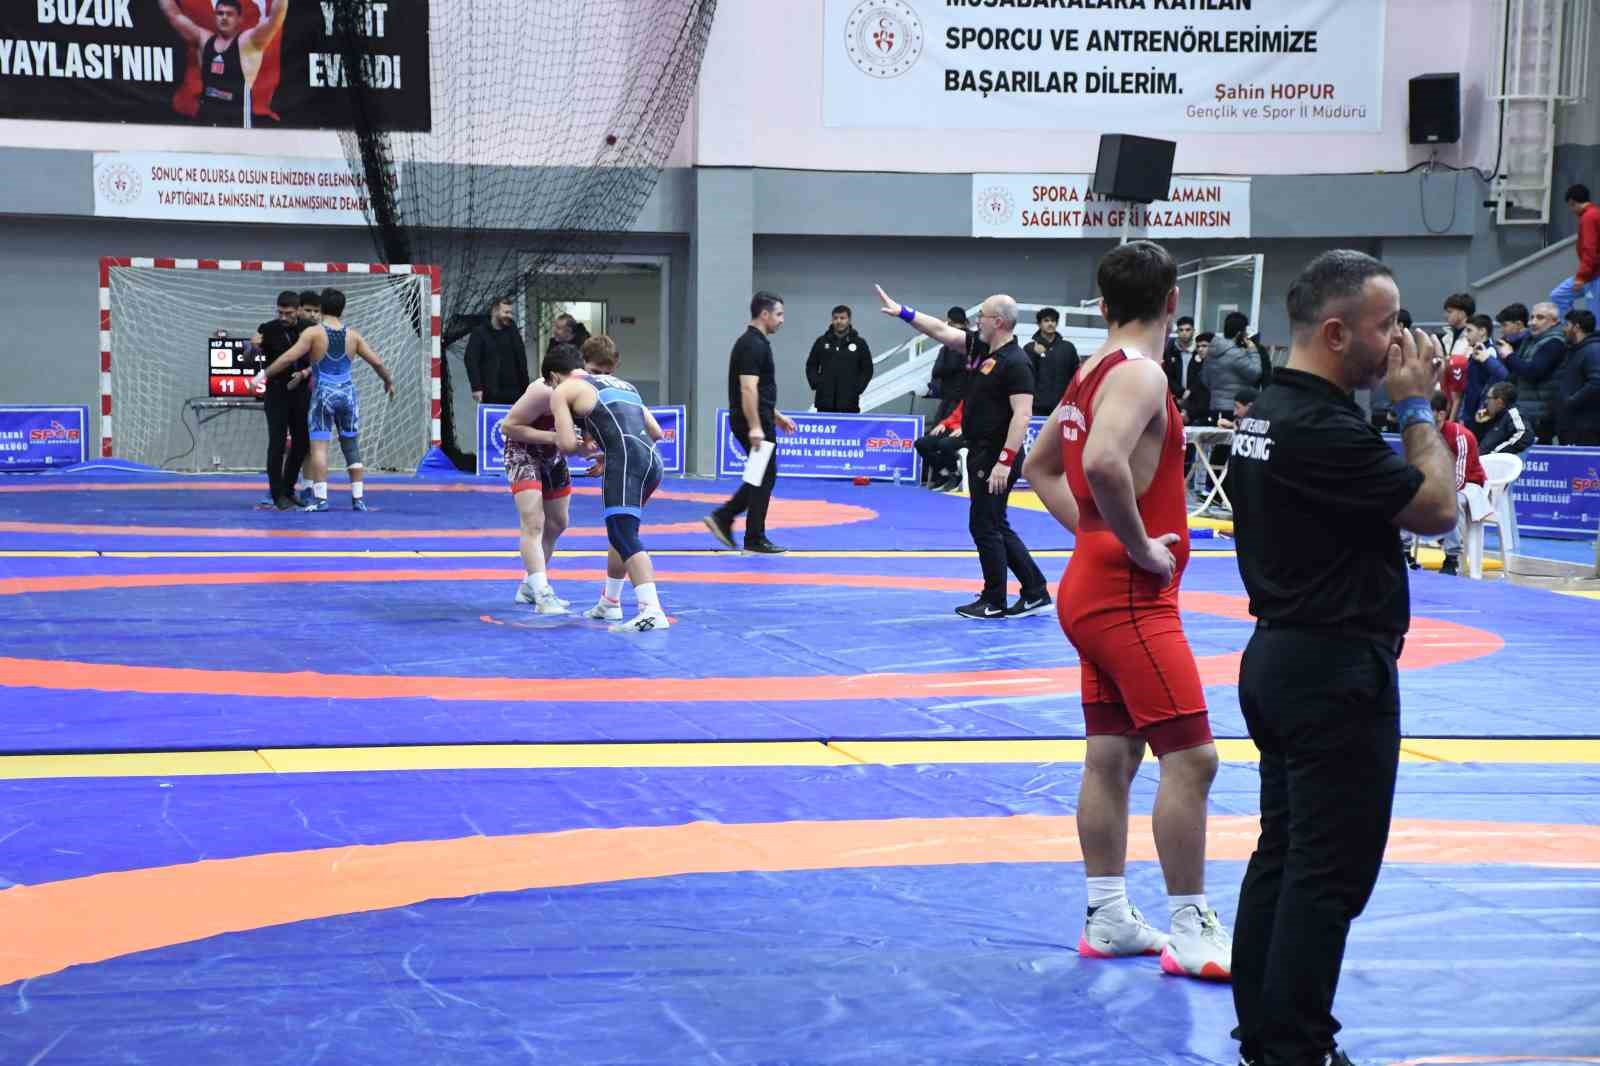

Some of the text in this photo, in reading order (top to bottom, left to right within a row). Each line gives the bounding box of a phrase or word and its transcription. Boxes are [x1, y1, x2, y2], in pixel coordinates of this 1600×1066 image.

[945, 25, 1318, 53] SPORCU VE ANTRENÖRLERİMİZE
[0, 39, 174, 82] YAYLASI'NIN
[944, 65, 1183, 98] BAŞARILAR DİLERİM.
[1215, 84, 1335, 101] Şahin HOPUR
[1186, 104, 1237, 120] Gençlik
[1243, 109, 1258, 118] ve
[1262, 105, 1296, 120] Spor
[1312, 104, 1367, 119] Müdürü
[151, 166, 183, 183] SONUÇ
[185, 168, 198, 182] NE
[200, 168, 235, 183] OLURSA
[238, 169, 268, 185] OLSUN
[1032, 186, 1078, 202] SPORA
[1171, 186, 1221, 202] AMANI
[1021, 207, 1104, 227] SAĞLIKTAN
[1144, 210, 1231, 227] KAZANIRSIN
[219, 379, 235, 393] 11
